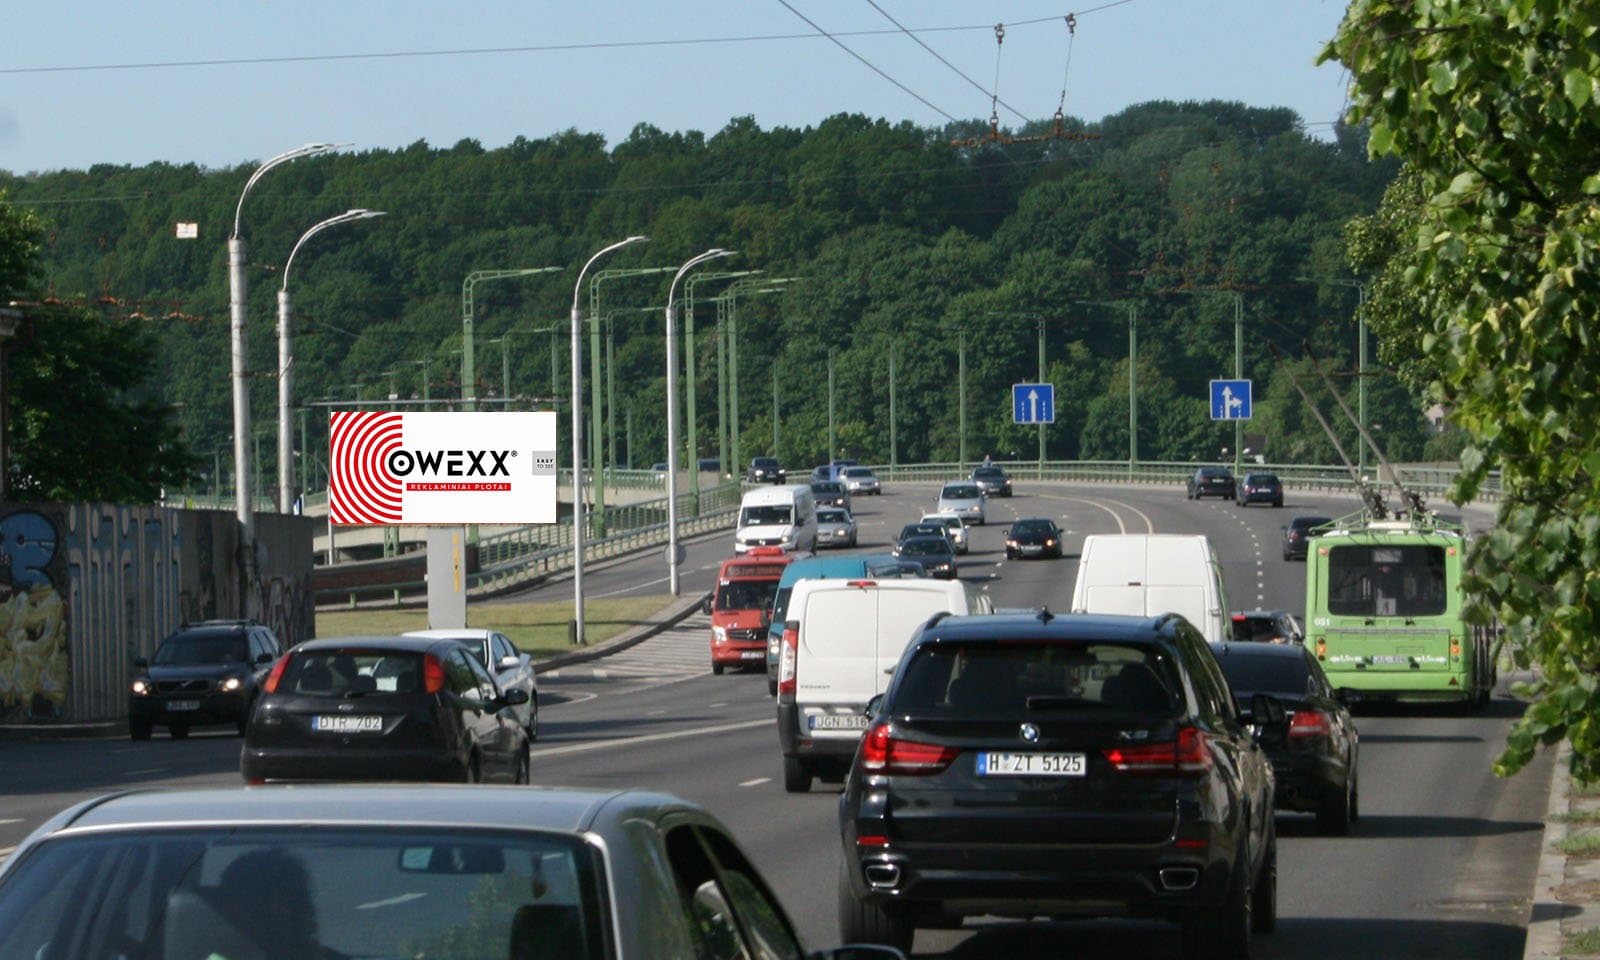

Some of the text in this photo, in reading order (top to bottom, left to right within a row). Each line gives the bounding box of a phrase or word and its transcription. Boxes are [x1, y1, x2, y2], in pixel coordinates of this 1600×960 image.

[388, 450, 510, 476] OWEXX
[319, 716, 381, 729] DTR 702
[817, 715, 840, 728] JGN
[989, 755, 1081, 771] H ZT 5125
